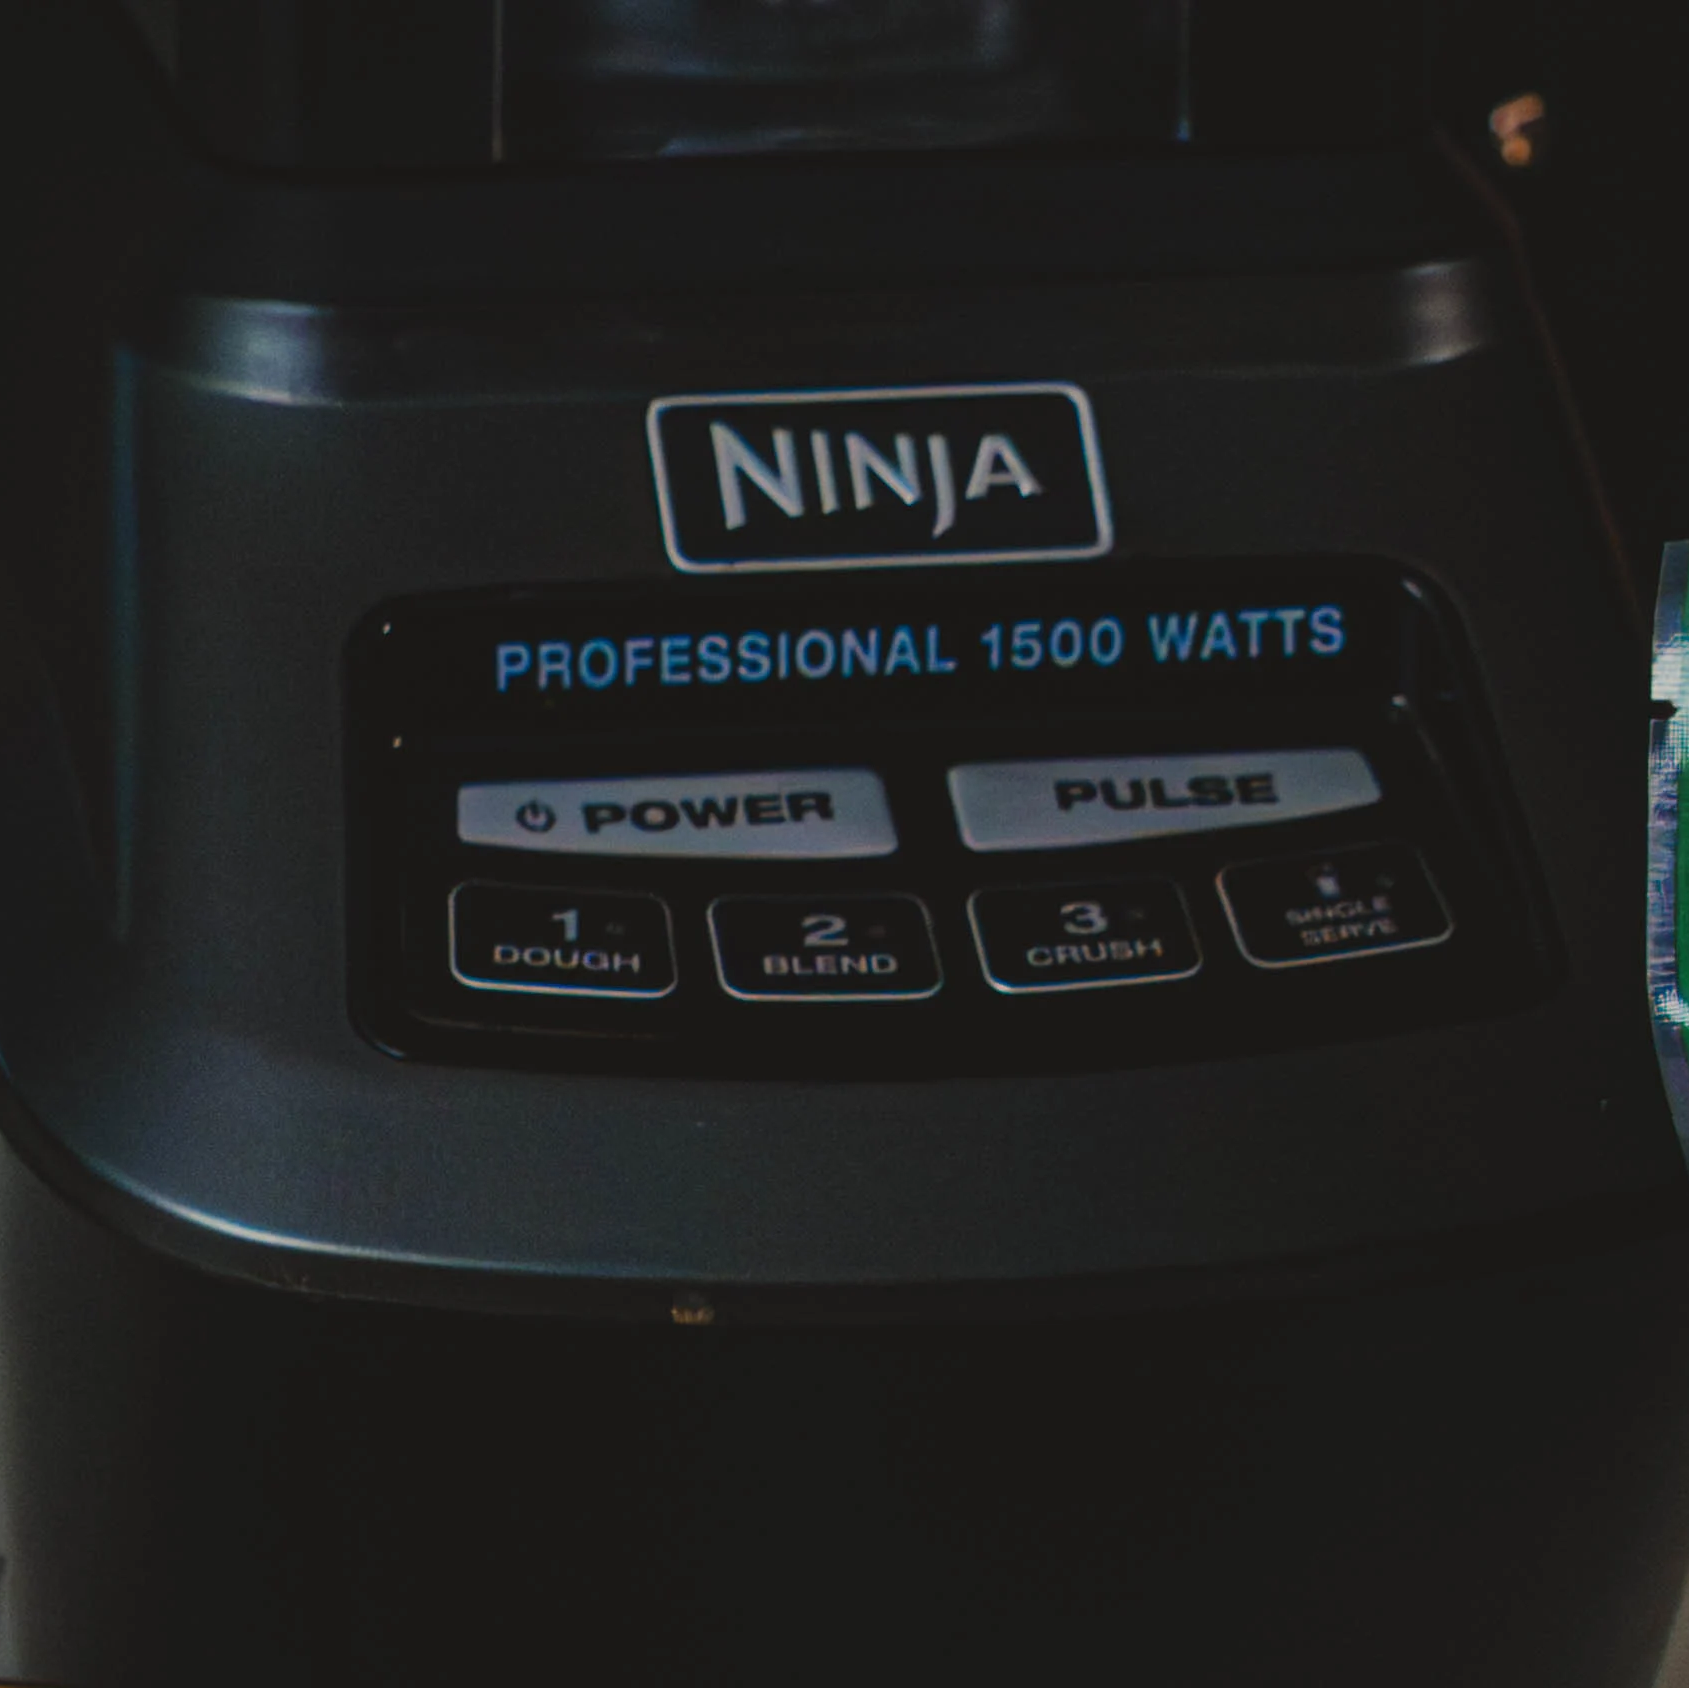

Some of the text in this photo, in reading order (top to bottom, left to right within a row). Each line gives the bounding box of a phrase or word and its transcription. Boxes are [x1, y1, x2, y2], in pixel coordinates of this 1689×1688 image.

[710, 421, 1046, 538] NINJA
[495, 603, 1346, 692] PROFESSIONAL 1500 WATTS
[1054, 772, 1278, 811] PULSE
[581, 791, 835, 833] POWER
[552, 909, 580, 943] 1
[801, 914, 850, 947] 2
[1060, 900, 1108, 935] 3
[493, 944, 641, 974] DOUGH
[763, 953, 899, 976] BLEND
[1026, 938, 1164, 967] CRUSH
